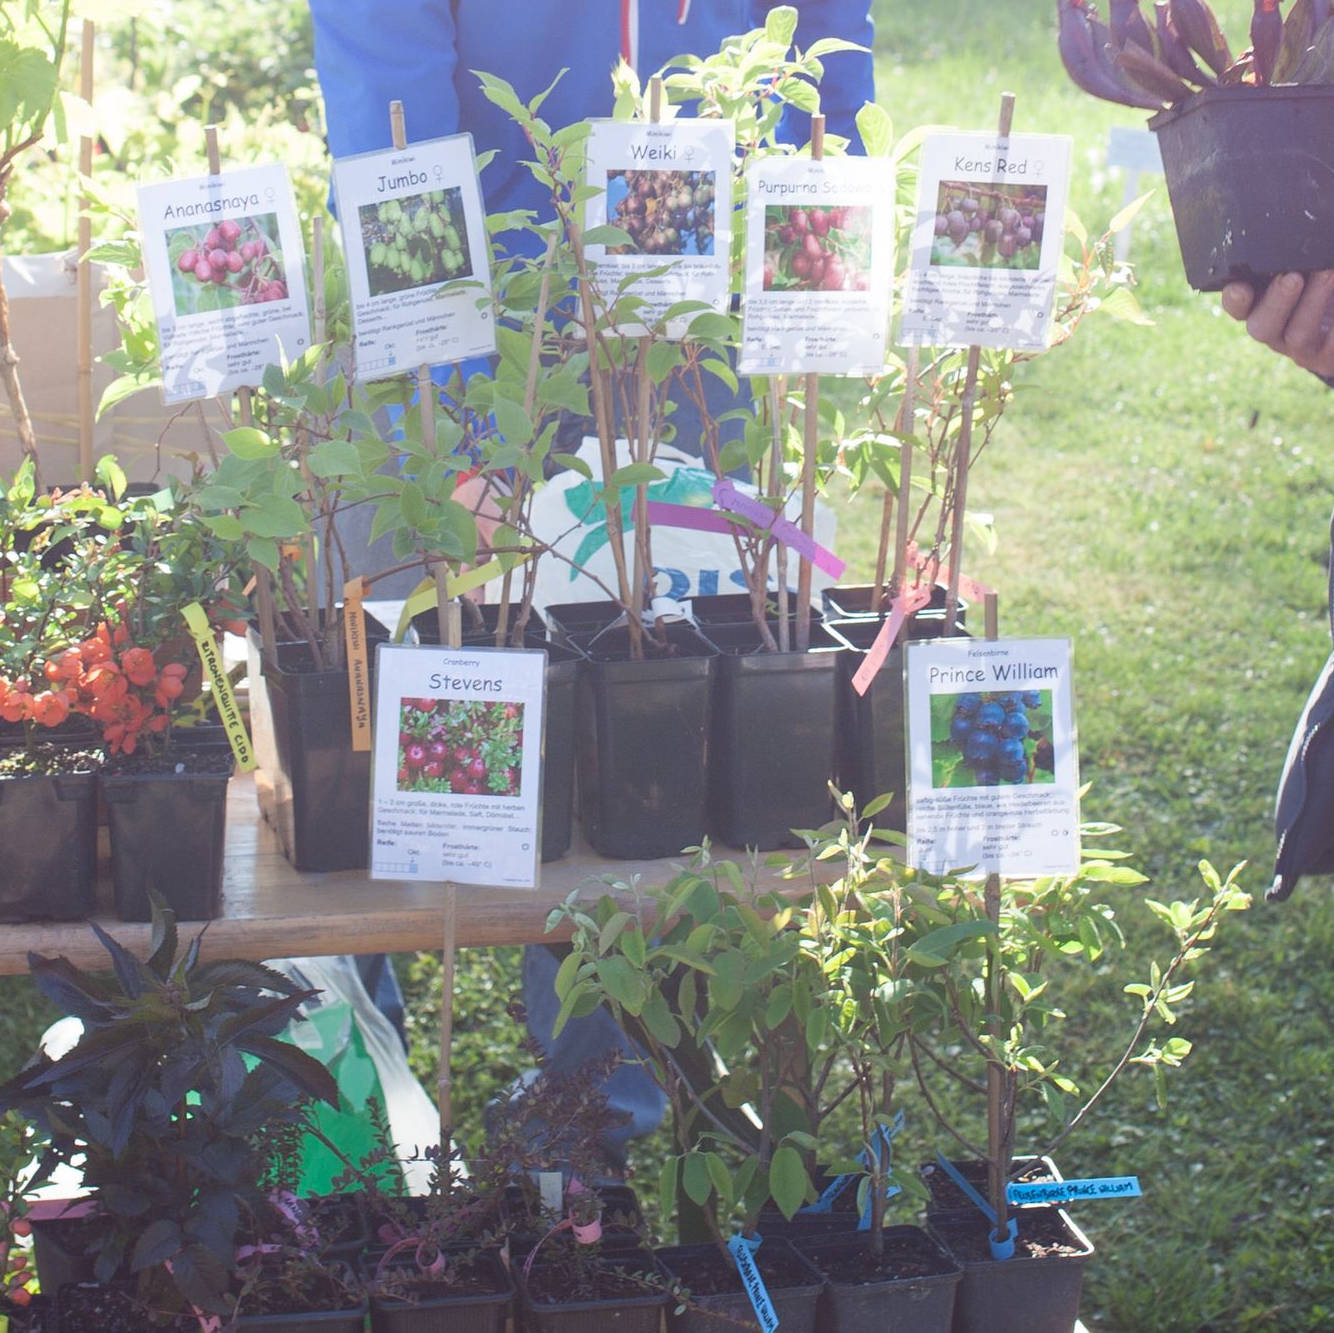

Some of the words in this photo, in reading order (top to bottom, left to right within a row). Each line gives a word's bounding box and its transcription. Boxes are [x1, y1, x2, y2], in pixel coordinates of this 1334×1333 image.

[631, 145, 677, 160] Weiki
[954, 156, 992, 173] Kens
[996, 157, 1028, 174] Red
[376, 169, 429, 193] Jumbo
[757, 179, 818, 197] Purpurna
[163, 193, 260, 220] Ananasnaya
[443, 657, 481, 668] Cranberry
[929, 666, 987, 684] Prince
[992, 662, 1059, 682] William
[429, 673, 503, 693] Stevens
